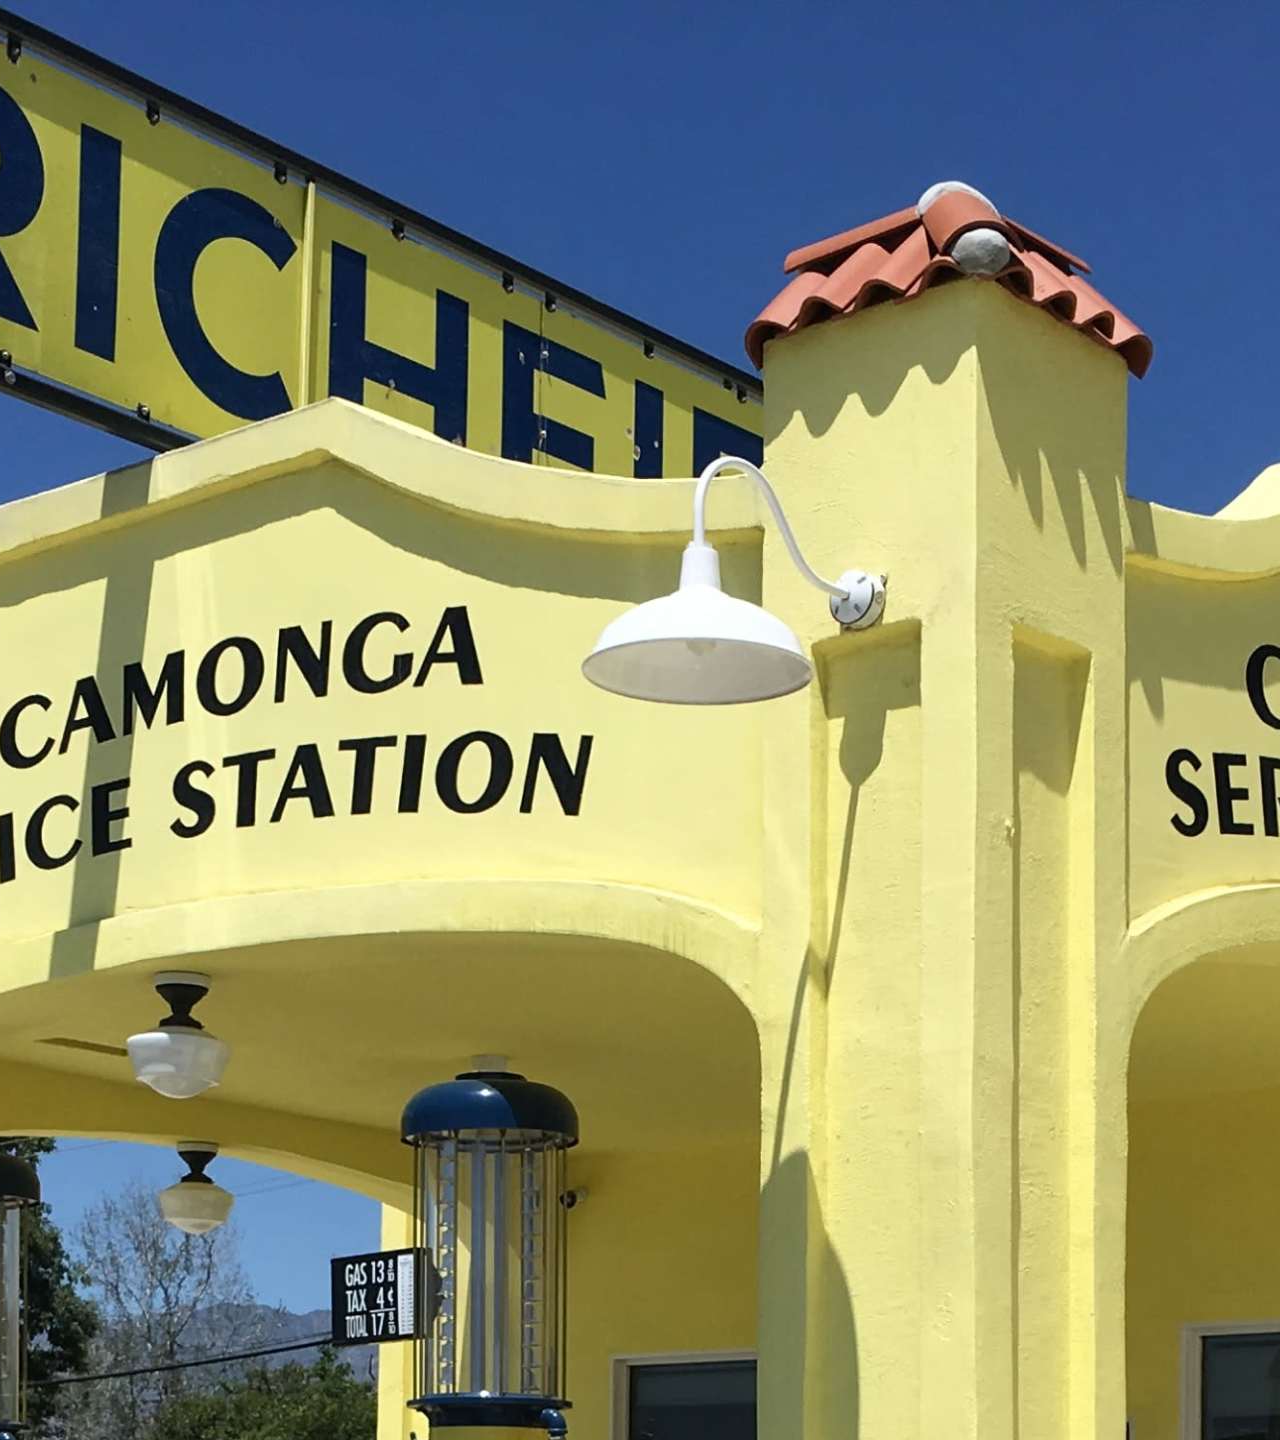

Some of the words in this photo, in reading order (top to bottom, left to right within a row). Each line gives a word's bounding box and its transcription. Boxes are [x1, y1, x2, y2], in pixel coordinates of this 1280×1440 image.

[170, 729, 594, 839] STATION
[345, 1261, 367, 1287] GAS
[371, 1260, 385, 1284] 13
[345, 1288, 367, 1314] TAX
[345, 1314, 368, 1339] TOTAL
[371, 1312, 385, 1336] 17
